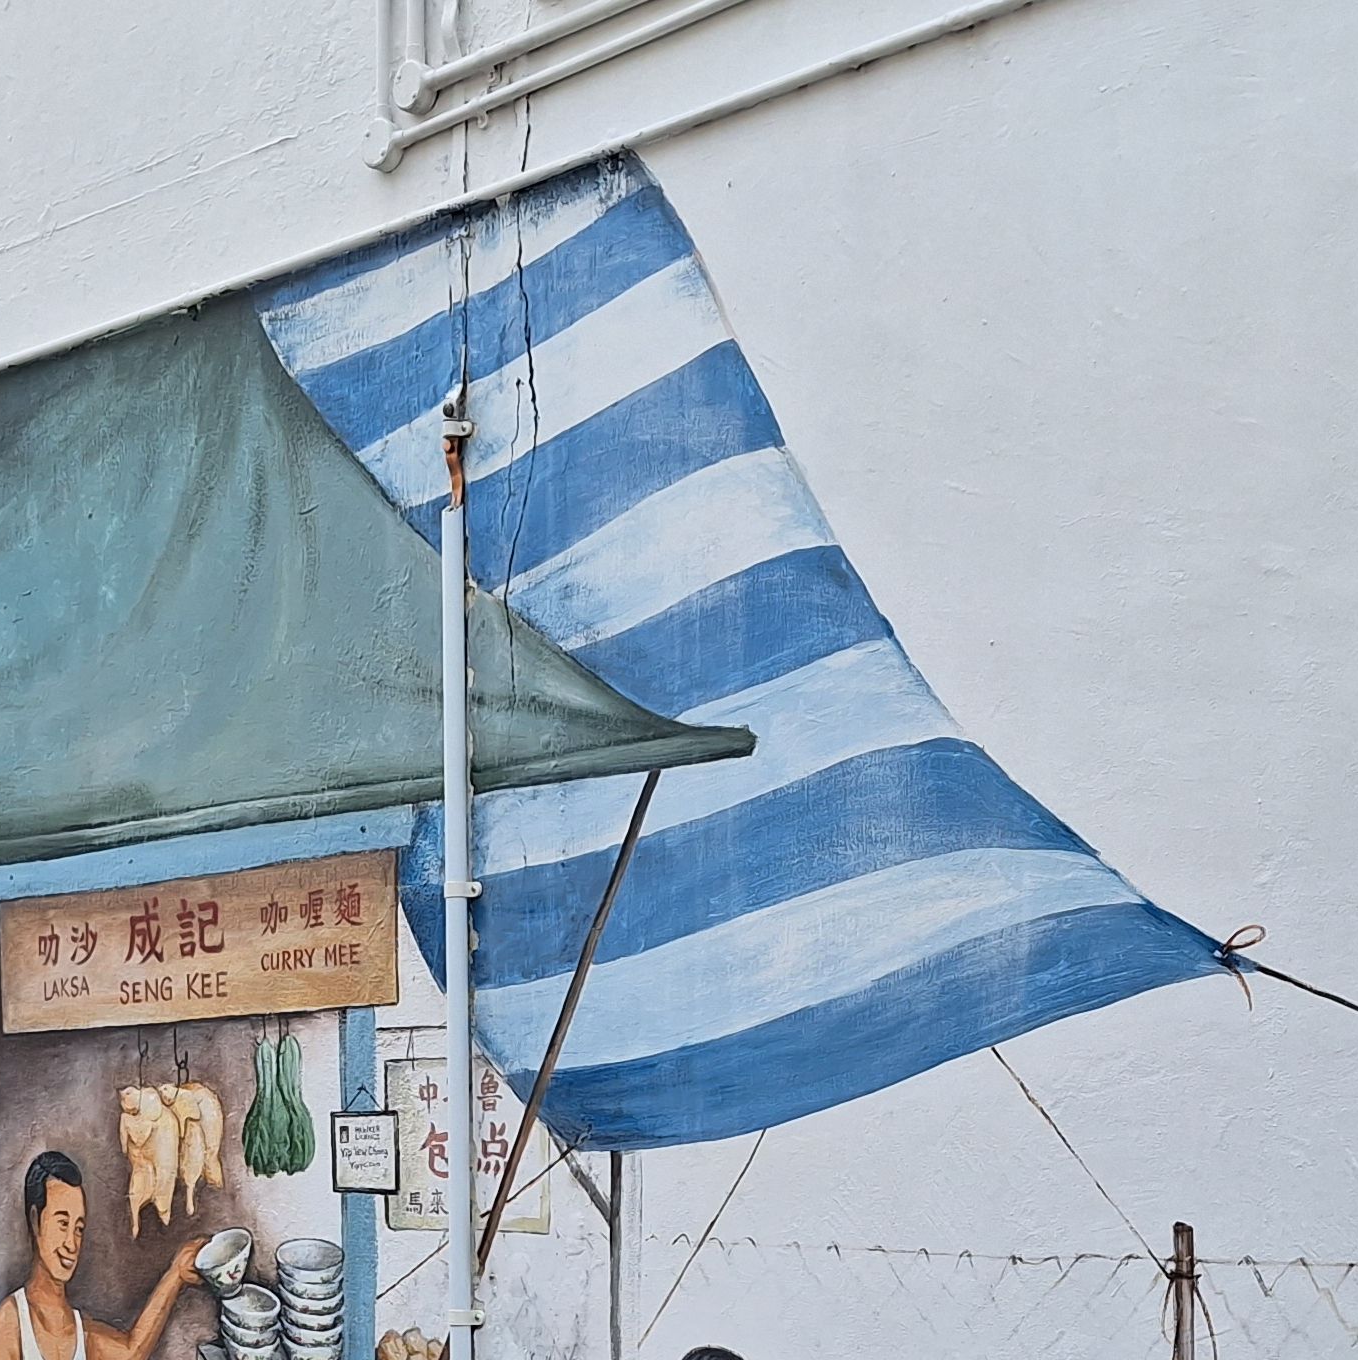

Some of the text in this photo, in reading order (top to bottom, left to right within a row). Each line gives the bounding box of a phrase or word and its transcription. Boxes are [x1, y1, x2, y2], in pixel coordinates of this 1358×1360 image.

[38, 921, 98, 966] 叻沙
[123, 896, 225, 964] 成記
[43, 942, 362, 1005] LAKSA SENG KEE CURRY MEE
